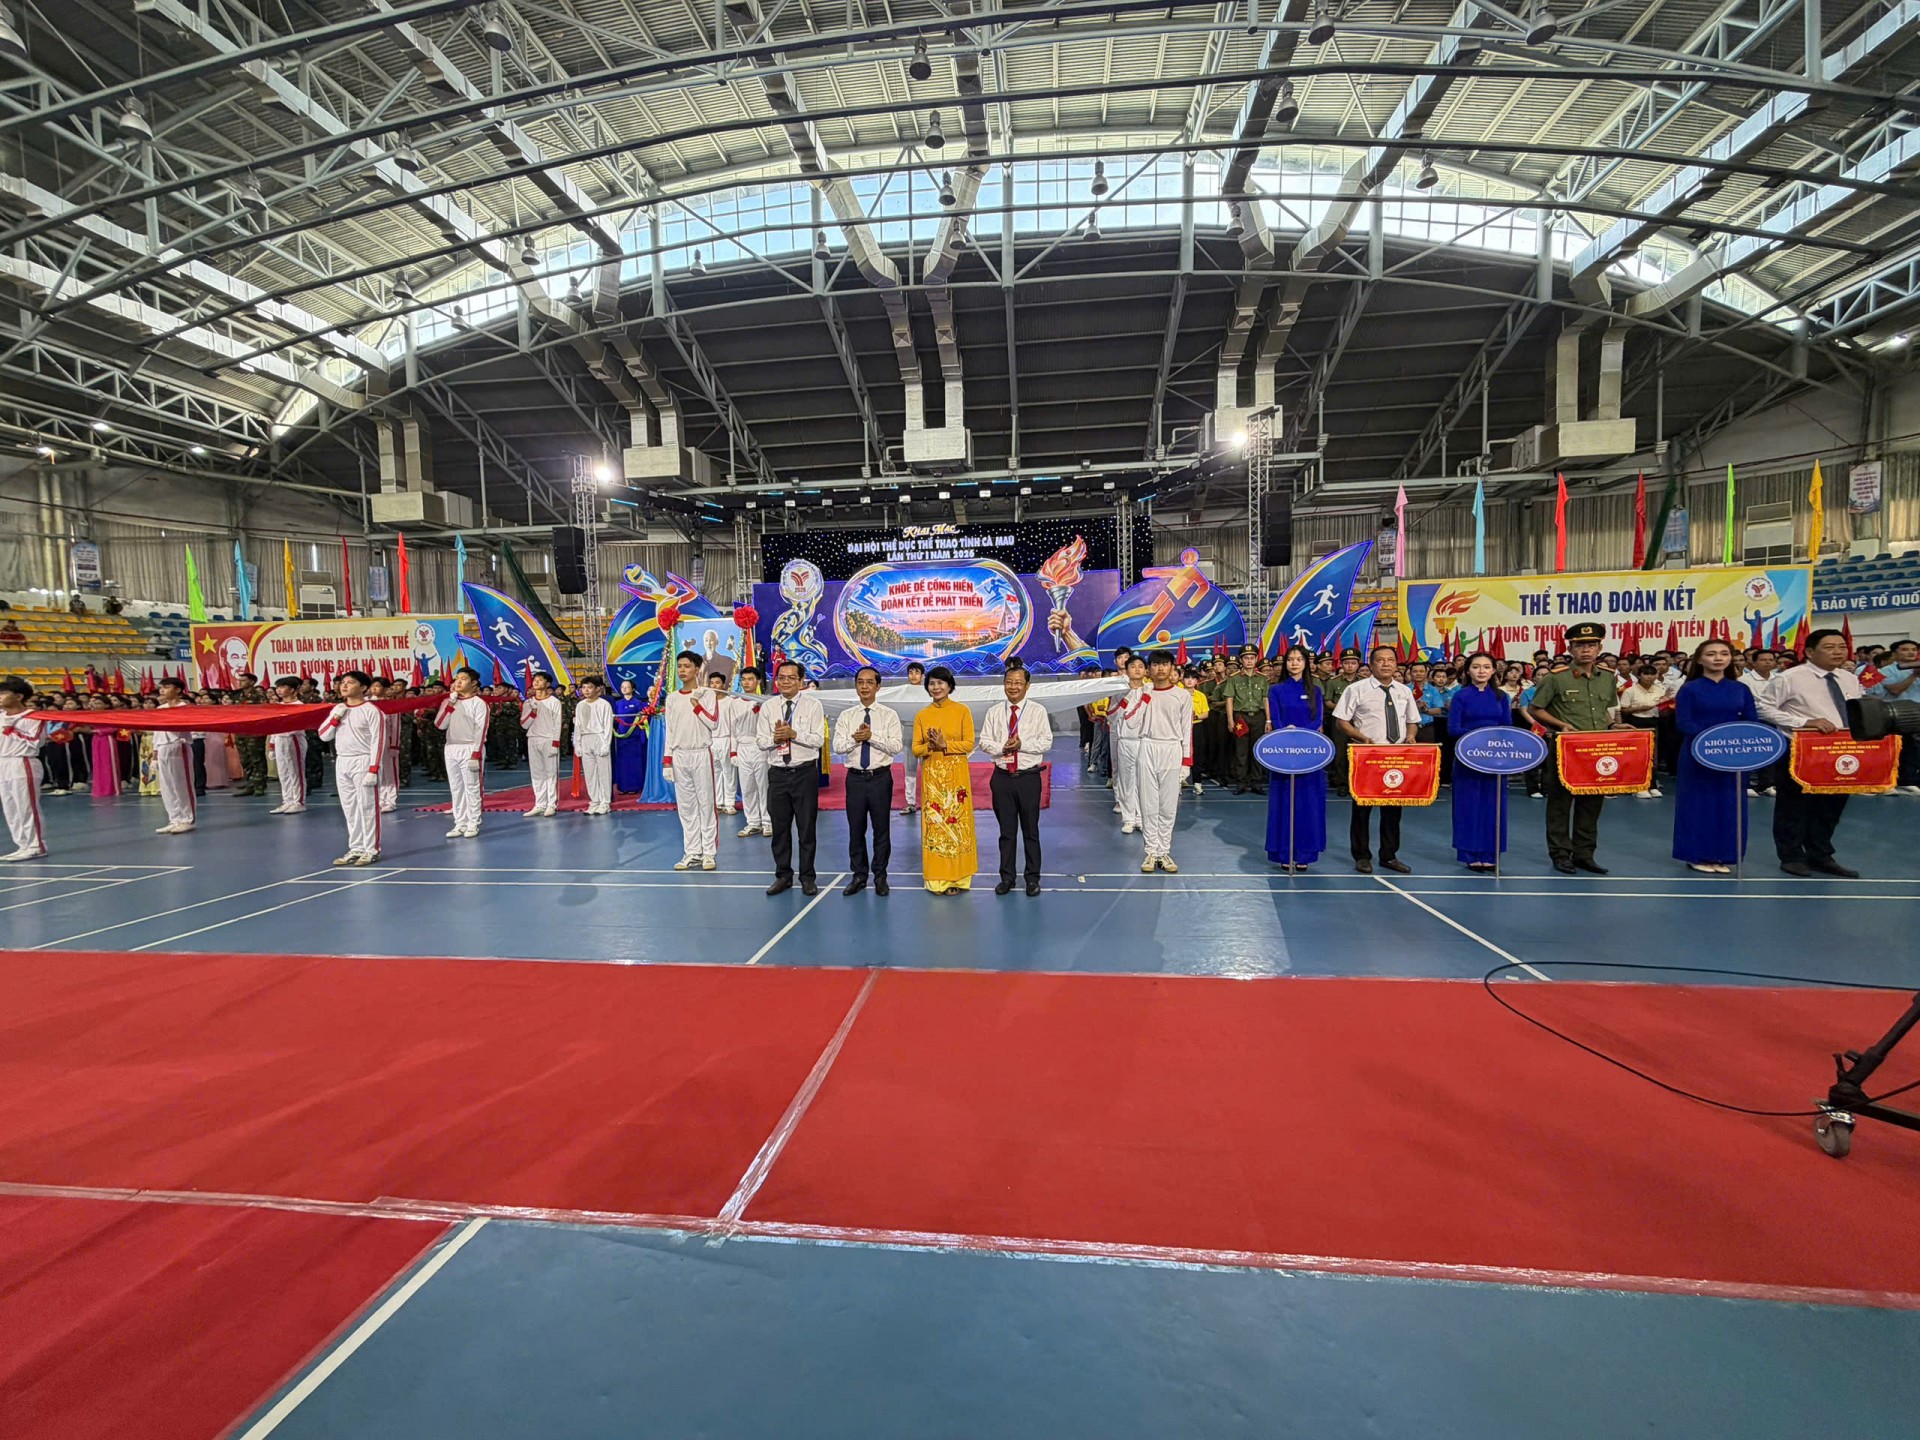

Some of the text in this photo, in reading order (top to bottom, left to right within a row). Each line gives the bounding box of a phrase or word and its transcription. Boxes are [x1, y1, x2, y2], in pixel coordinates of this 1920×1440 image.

[935, 538, 958, 549] THAO
[953, 549, 975, 558] 2026
[935, 594, 957, 606] PHÁT
[1519, 581, 1696, 615] THỂ THAO ĐOÀN KẾT
[1821, 596, 1847, 610] BẢO
[1850, 595, 1868, 610] VỆ
[1871, 591, 1889, 607] TỔ
[270, 636, 294, 653] TOÀN
[296, 636, 314, 652] DÂN
[316, 636, 333, 652] RÈN
[335, 634, 363, 653] LUYỆN
[365, 634, 390, 651] THÂN
[392, 630, 410, 650] THỂ
[272, 660, 297, 675] THEO
[393, 657, 411, 674] ĐẠI
[1487, 739, 1514, 748] ĐOÀN
[1262, 746, 1326, 755] ĐOÀN TRỌNG TÀI
[1466, 748, 1493, 758] CÔNG
